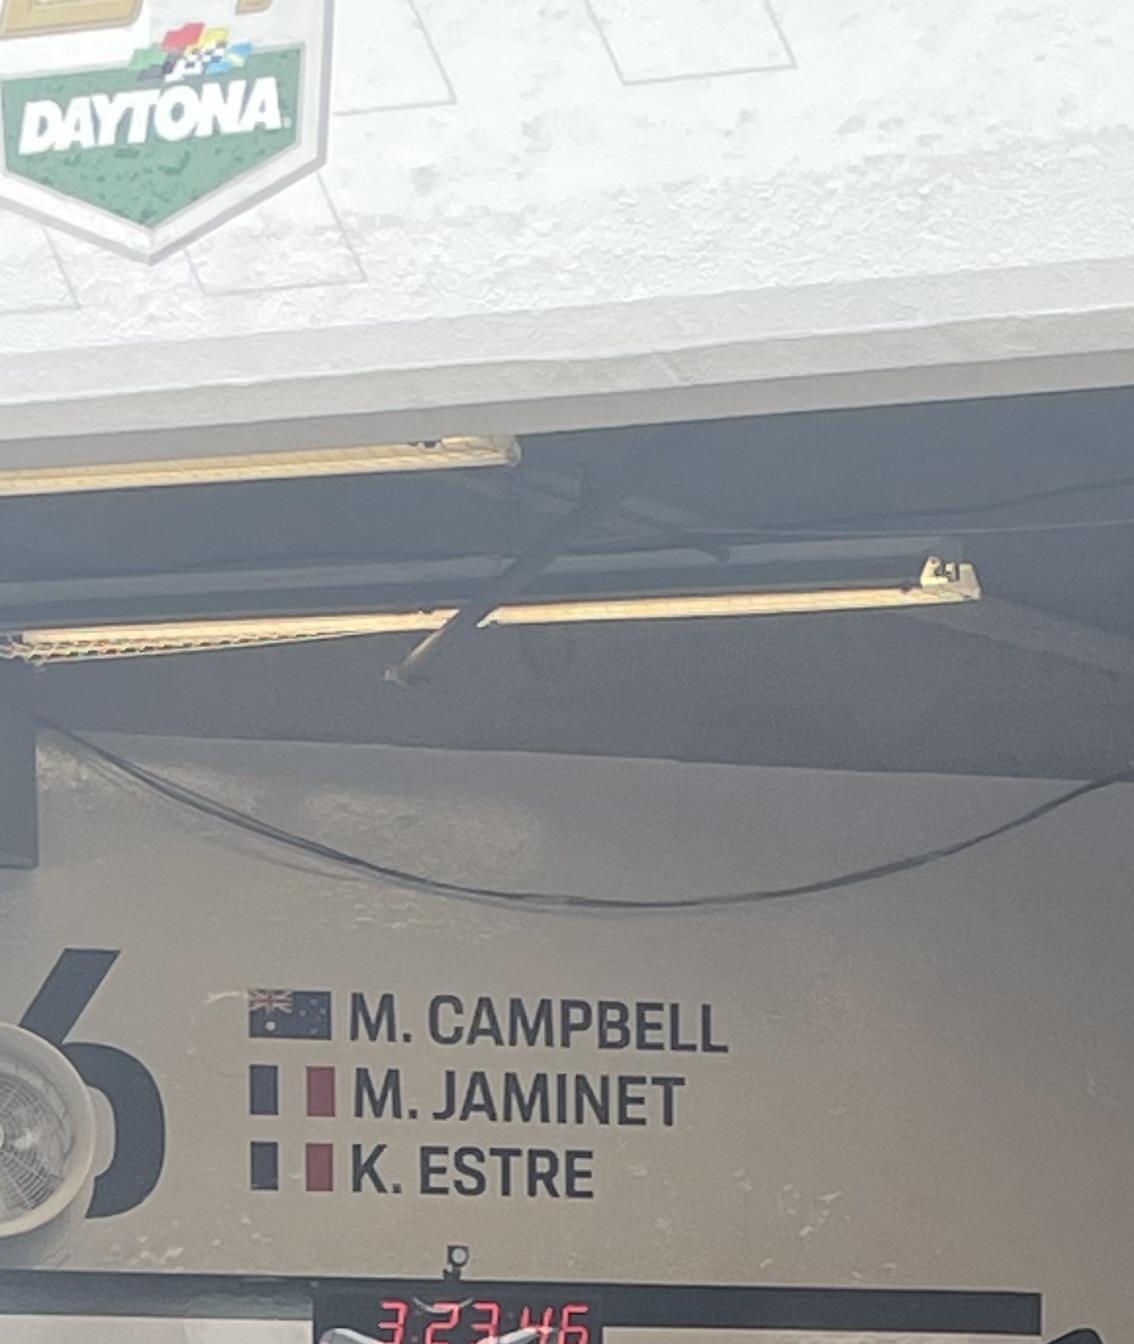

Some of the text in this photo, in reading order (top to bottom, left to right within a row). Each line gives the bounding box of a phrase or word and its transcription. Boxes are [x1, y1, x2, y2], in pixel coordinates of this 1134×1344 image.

[18, 76, 282, 155] DAYTONA
[349, 993, 730, 1054] M. CAMPBELL
[353, 1067, 686, 1127] M. JAMINET
[352, 1144, 595, 1199] K. ESTRE
